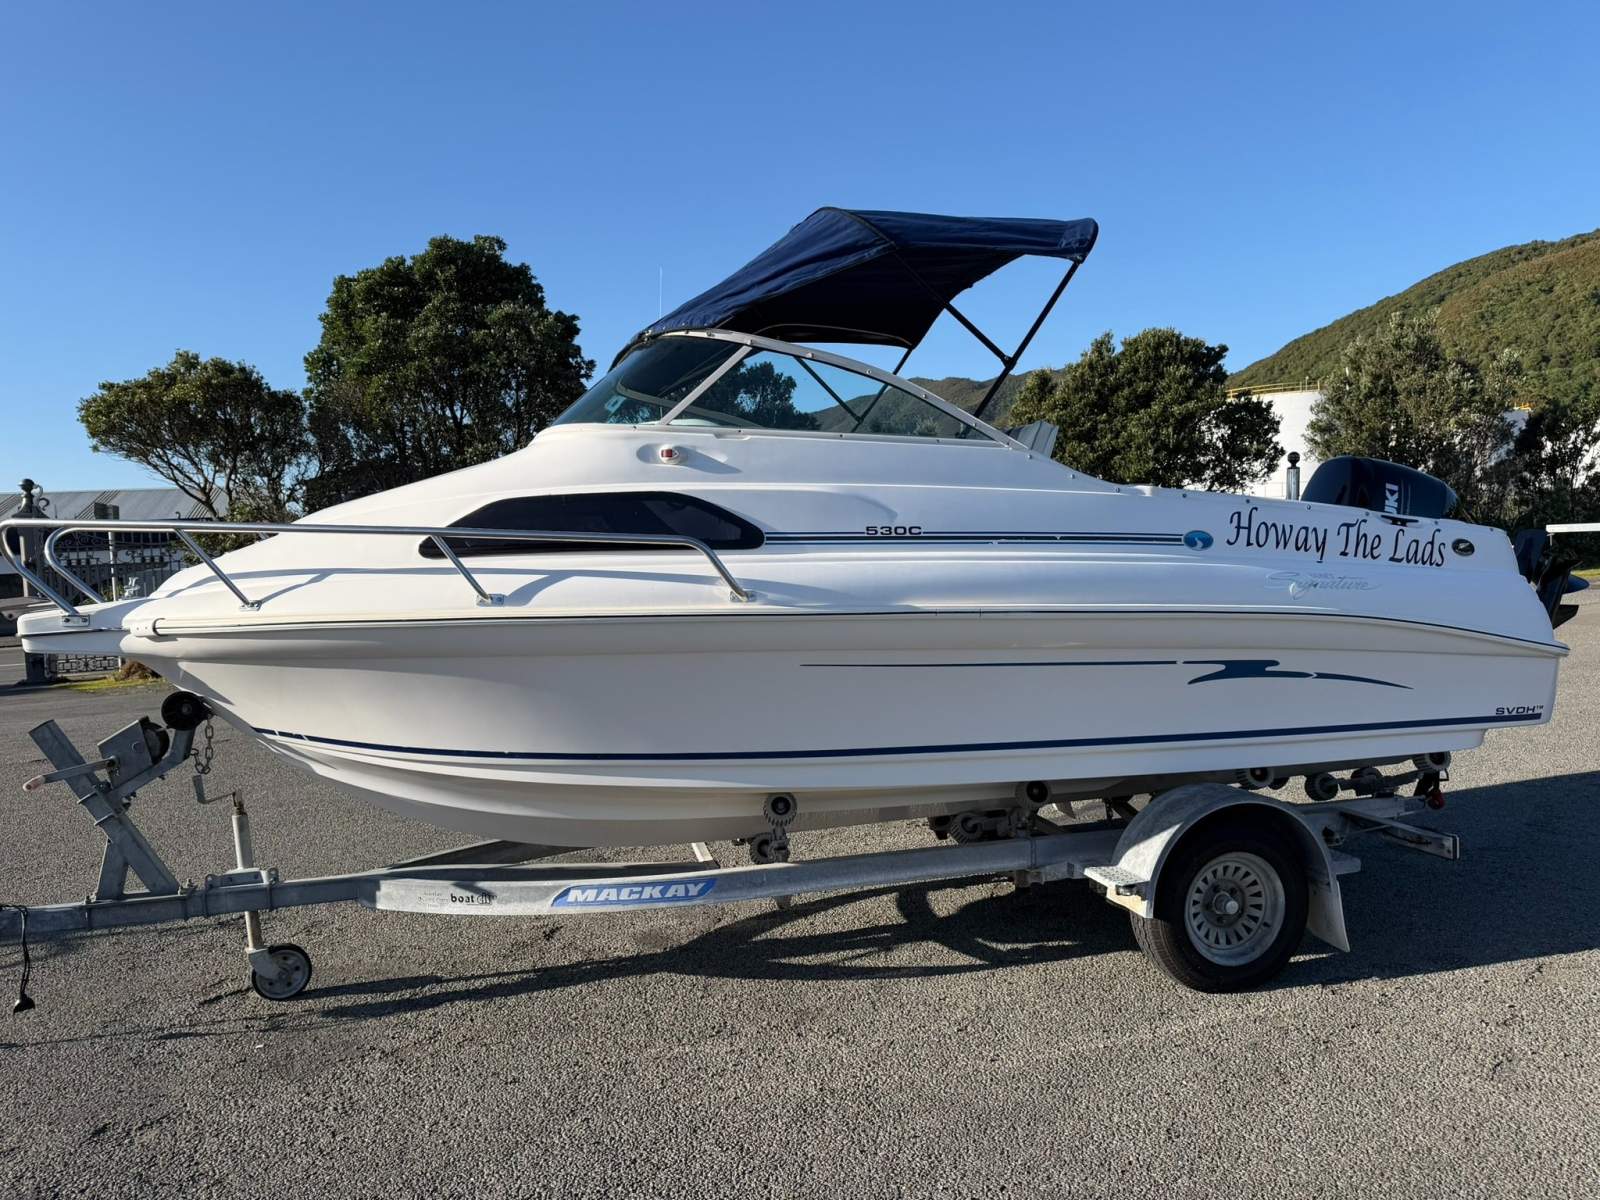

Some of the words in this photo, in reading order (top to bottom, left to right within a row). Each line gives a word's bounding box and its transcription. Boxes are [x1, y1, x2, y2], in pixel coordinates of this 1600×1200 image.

[865, 526, 922, 536] 530C
[1226, 507, 1328, 563] Howay
[1336, 519, 1382, 560] The
[1388, 528, 1446, 567] Lads
[450, 893, 475, 904] boat
[566, 882, 708, 903] MACKAY
